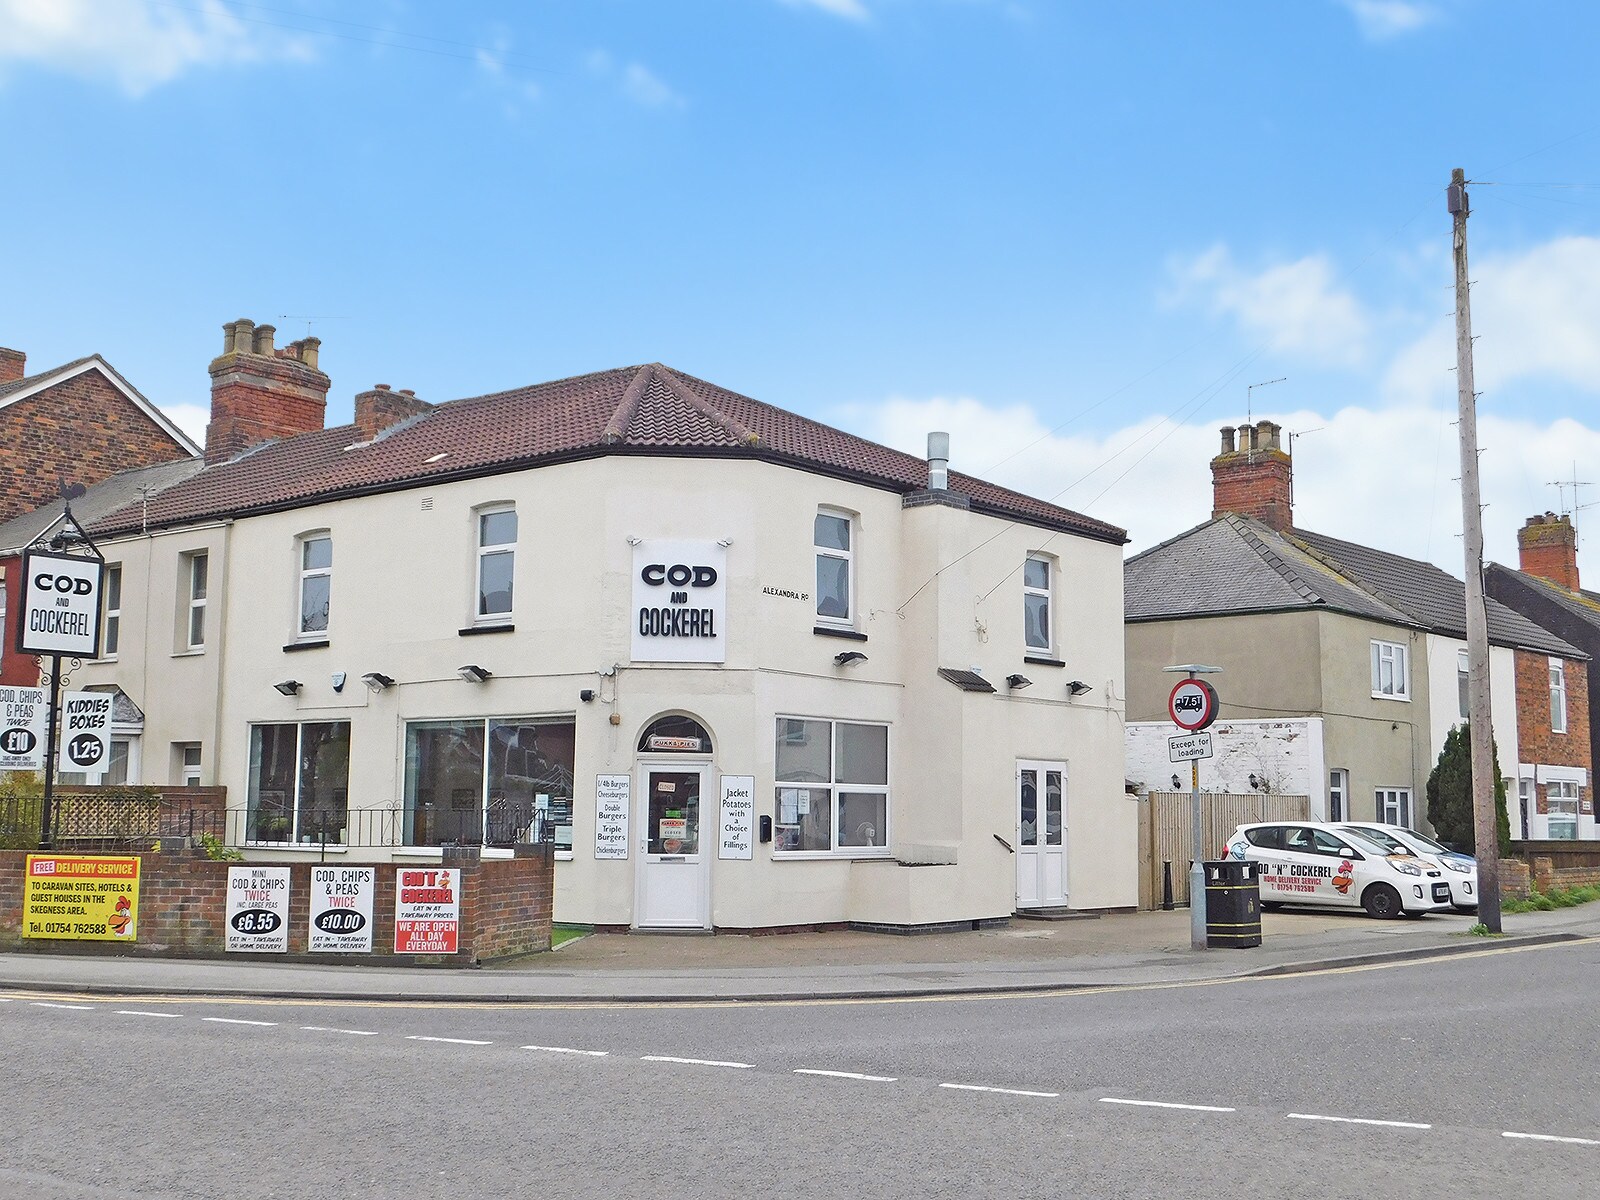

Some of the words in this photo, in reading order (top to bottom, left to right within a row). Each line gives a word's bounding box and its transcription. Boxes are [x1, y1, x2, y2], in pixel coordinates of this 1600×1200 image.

[641, 564, 718, 587] COD
[34, 574, 92, 595] COD
[670, 592, 688, 604] AND
[762, 586, 800, 600] ALEXANDRA
[56, 597, 70, 607] AND
[30, 608, 90, 636] COCKEREL
[639, 607, 717, 638] COCKEREL
[20, 690, 42, 704] CHIPS
[6, 704, 12, 717] &
[14, 704, 34, 718] PEAS
[66, 698, 110, 714] KIDDIES
[6, 718, 32, 726] TWICE
[69, 715, 105, 730] BOXES
[8, 731, 28, 752] £10
[1171, 740, 1196, 750] Except
[71, 740, 101, 760] 1.25
[1178, 748, 1204, 757] loading
[611, 780, 628, 789] Burgers
[598, 790, 628, 800] Cheeseburgers
[726, 789, 748, 799] Jacket
[723, 799, 751, 808] Potatoes
[598, 812, 626, 821] Burgers
[603, 825, 622, 834] Triple
[598, 833, 626, 843] Burgers
[724, 841, 748, 851] Fillings
[35, 863, 54, 872] FREE
[56, 863, 96, 874] DELIVERY
[97, 864, 133, 874] SERVICE
[252, 870, 267, 878] MINI
[1258, 863, 1269, 874] OD
[1291, 865, 1332, 878] COCKEREL
[341, 870, 370, 882] CHIPS
[402, 872, 424, 887] COD
[32, 882, 41, 890] TO
[42, 882, 73, 891] CARAVAN
[75, 883, 97, 892] SITES,
[98, 884, 125, 892] HOTELS
[126, 884, 132, 892] &
[232, 879, 248, 889] COD
[251, 879, 257, 889] &
[260, 879, 285, 889] CHIPS
[326, 883, 332, 895] &
[336, 884, 359, 895] PEAS
[30, 894, 52, 902] GUEST
[54, 894, 82, 903] HOUSES
[83, 895, 91, 903] IN
[92, 895, 105, 904] THE
[244, 890, 270, 901] TWICE
[401, 888, 454, 904] COCKEREL
[329, 896, 355, 908] TWICE
[30, 906, 66, 915] SKEGNESS
[66, 906, 87, 915] AREA.
[237, 913, 274, 931] £6.55
[321, 914, 360, 930] £10.00
[398, 922, 412, 932] WE
[414, 922, 430, 932] ARE
[433, 922, 455, 932] OPEN
[29, 922, 43, 933] Tel.
[45, 922, 71, 933] 01754
[73, 923, 106, 934] 762588
[410, 932, 425, 941] ALL
[428, 932, 444, 941] DAY
[406, 941, 448, 950] EVERYDAY
